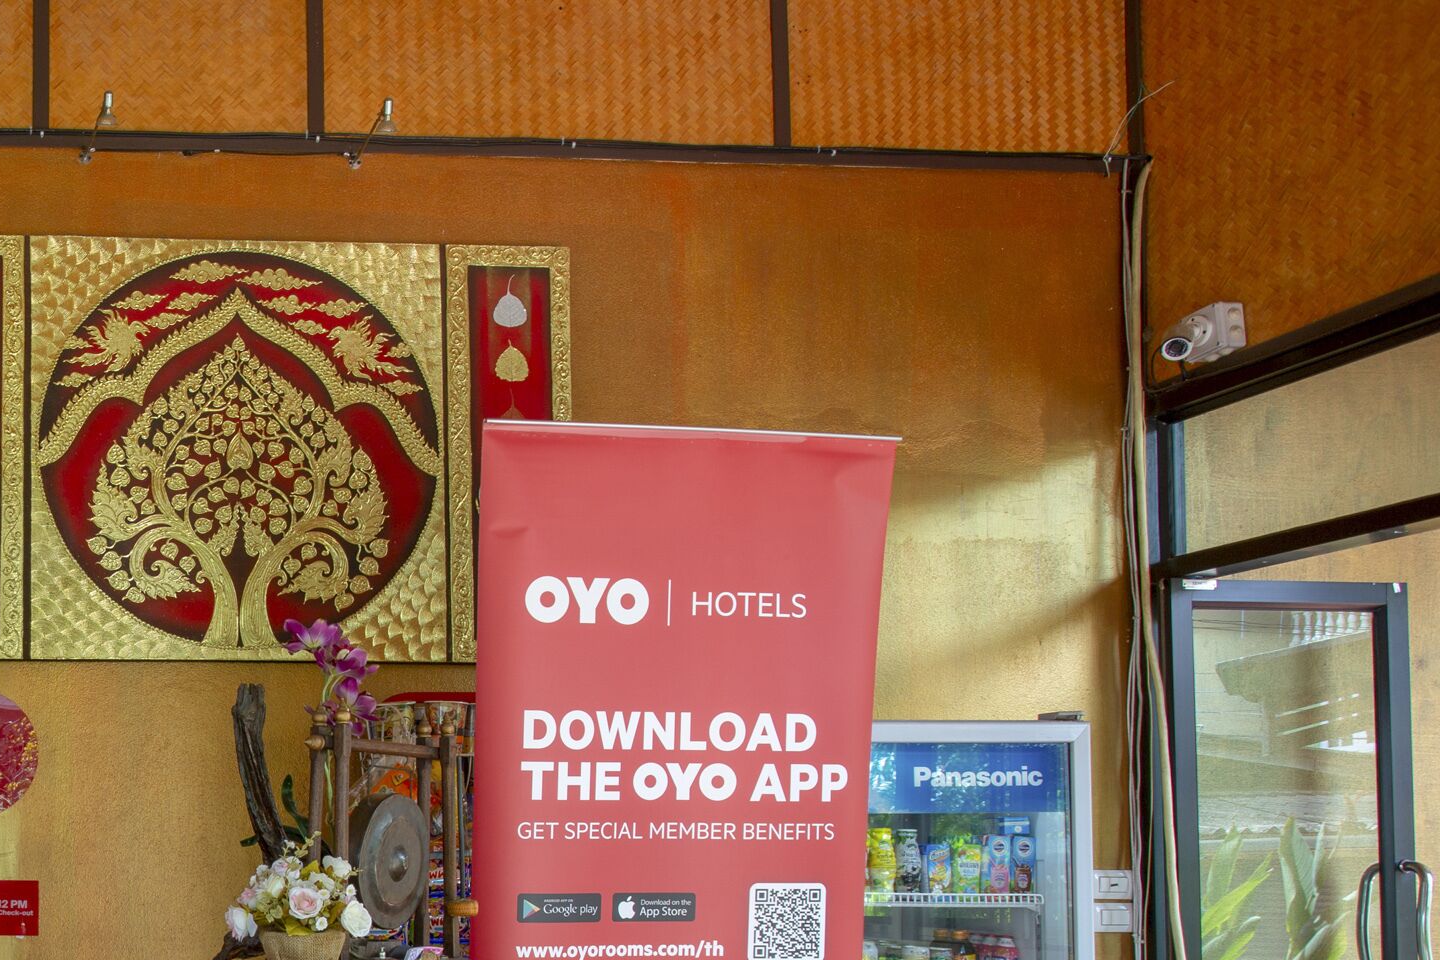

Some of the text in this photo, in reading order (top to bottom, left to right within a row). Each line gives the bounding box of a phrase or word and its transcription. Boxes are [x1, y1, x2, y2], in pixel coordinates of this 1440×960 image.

[525, 576, 807, 625] OYO HOTELS
[522, 709, 817, 752] DOWNLOAD
[521, 761, 849, 803] THE OYO APP
[913, 766, 1044, 788] Panasonic
[517, 821, 835, 841] GET SPECIAL MEMBER BENEFITS
[10, 899, 28, 909] PM
[543, 903, 598, 918] Google play
[639, 906, 688, 918] App Store
[640, 898, 671, 906] Download
